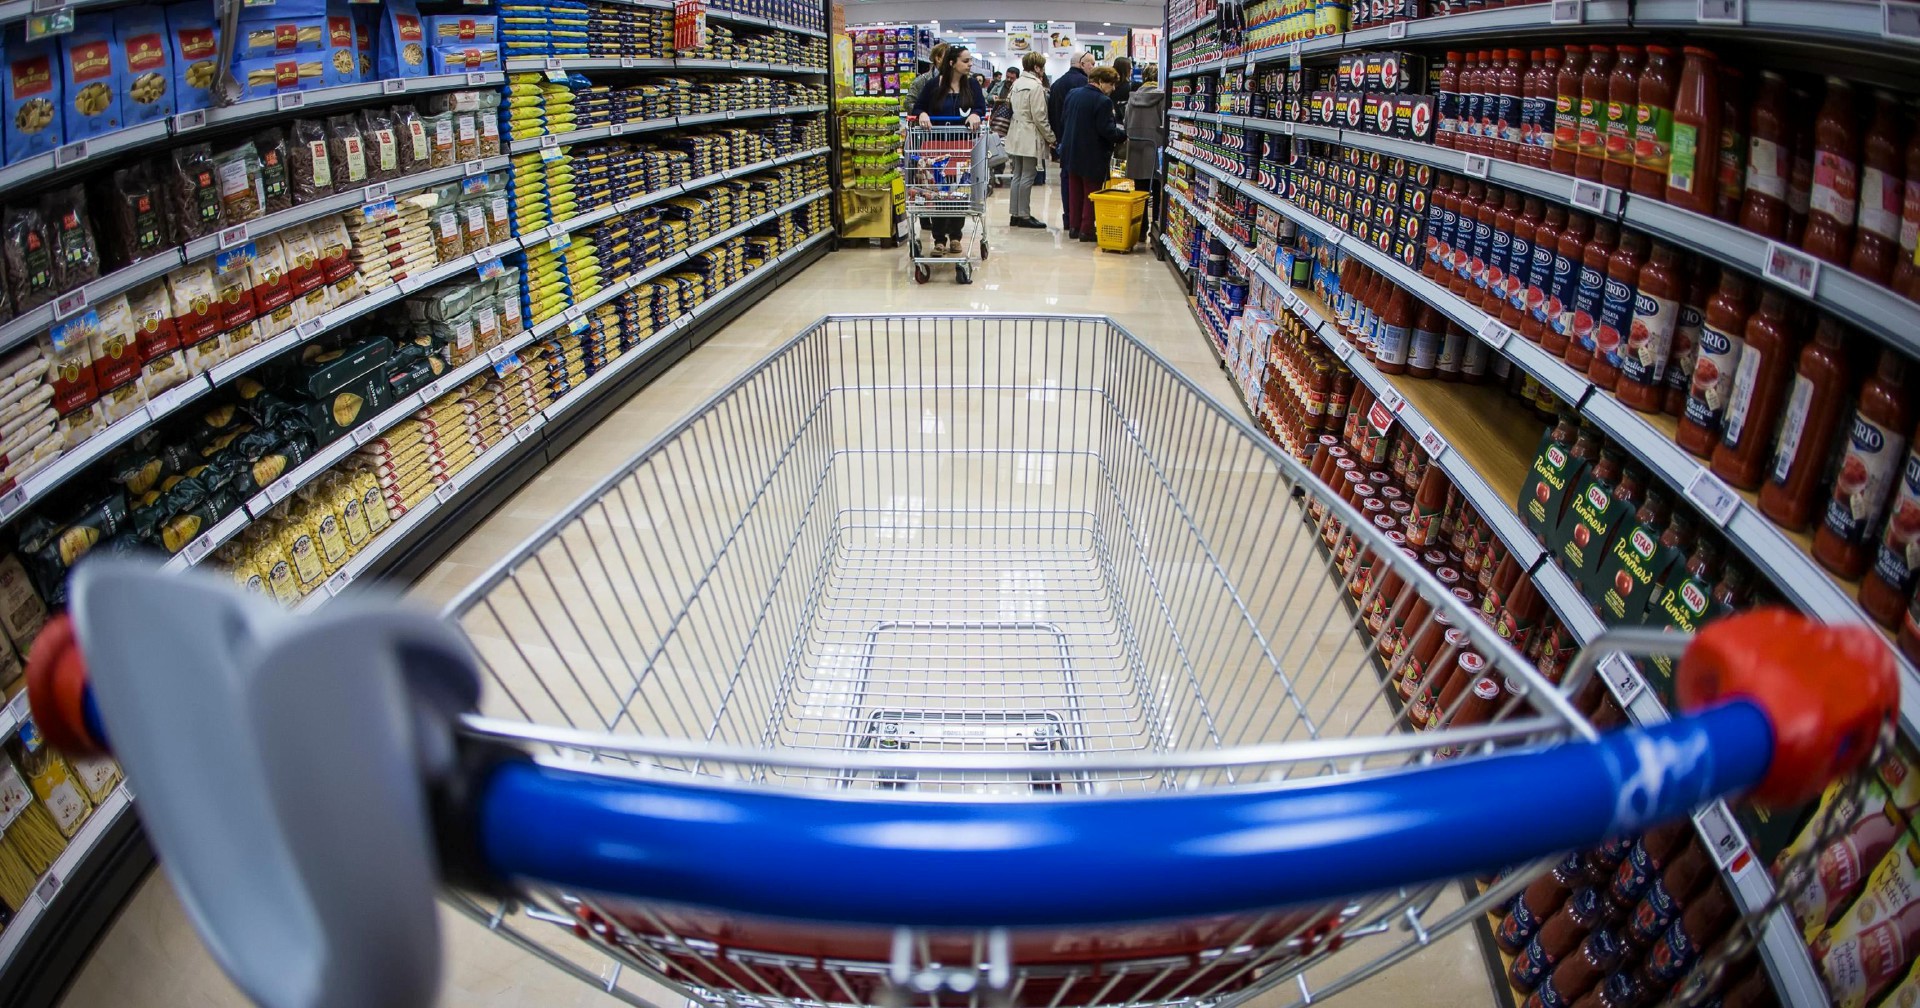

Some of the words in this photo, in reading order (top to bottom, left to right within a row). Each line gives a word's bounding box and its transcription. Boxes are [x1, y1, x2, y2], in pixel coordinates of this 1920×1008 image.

[1548, 449, 1563, 466] STAR
[1534, 455, 1565, 490] Pummarò
[1590, 488, 1605, 508] STAR
[1572, 494, 1607, 535] Pummarò
[1634, 532, 1651, 554] STAR
[1614, 537, 1653, 584] Pummarò
[1684, 586, 1703, 610] STAR
